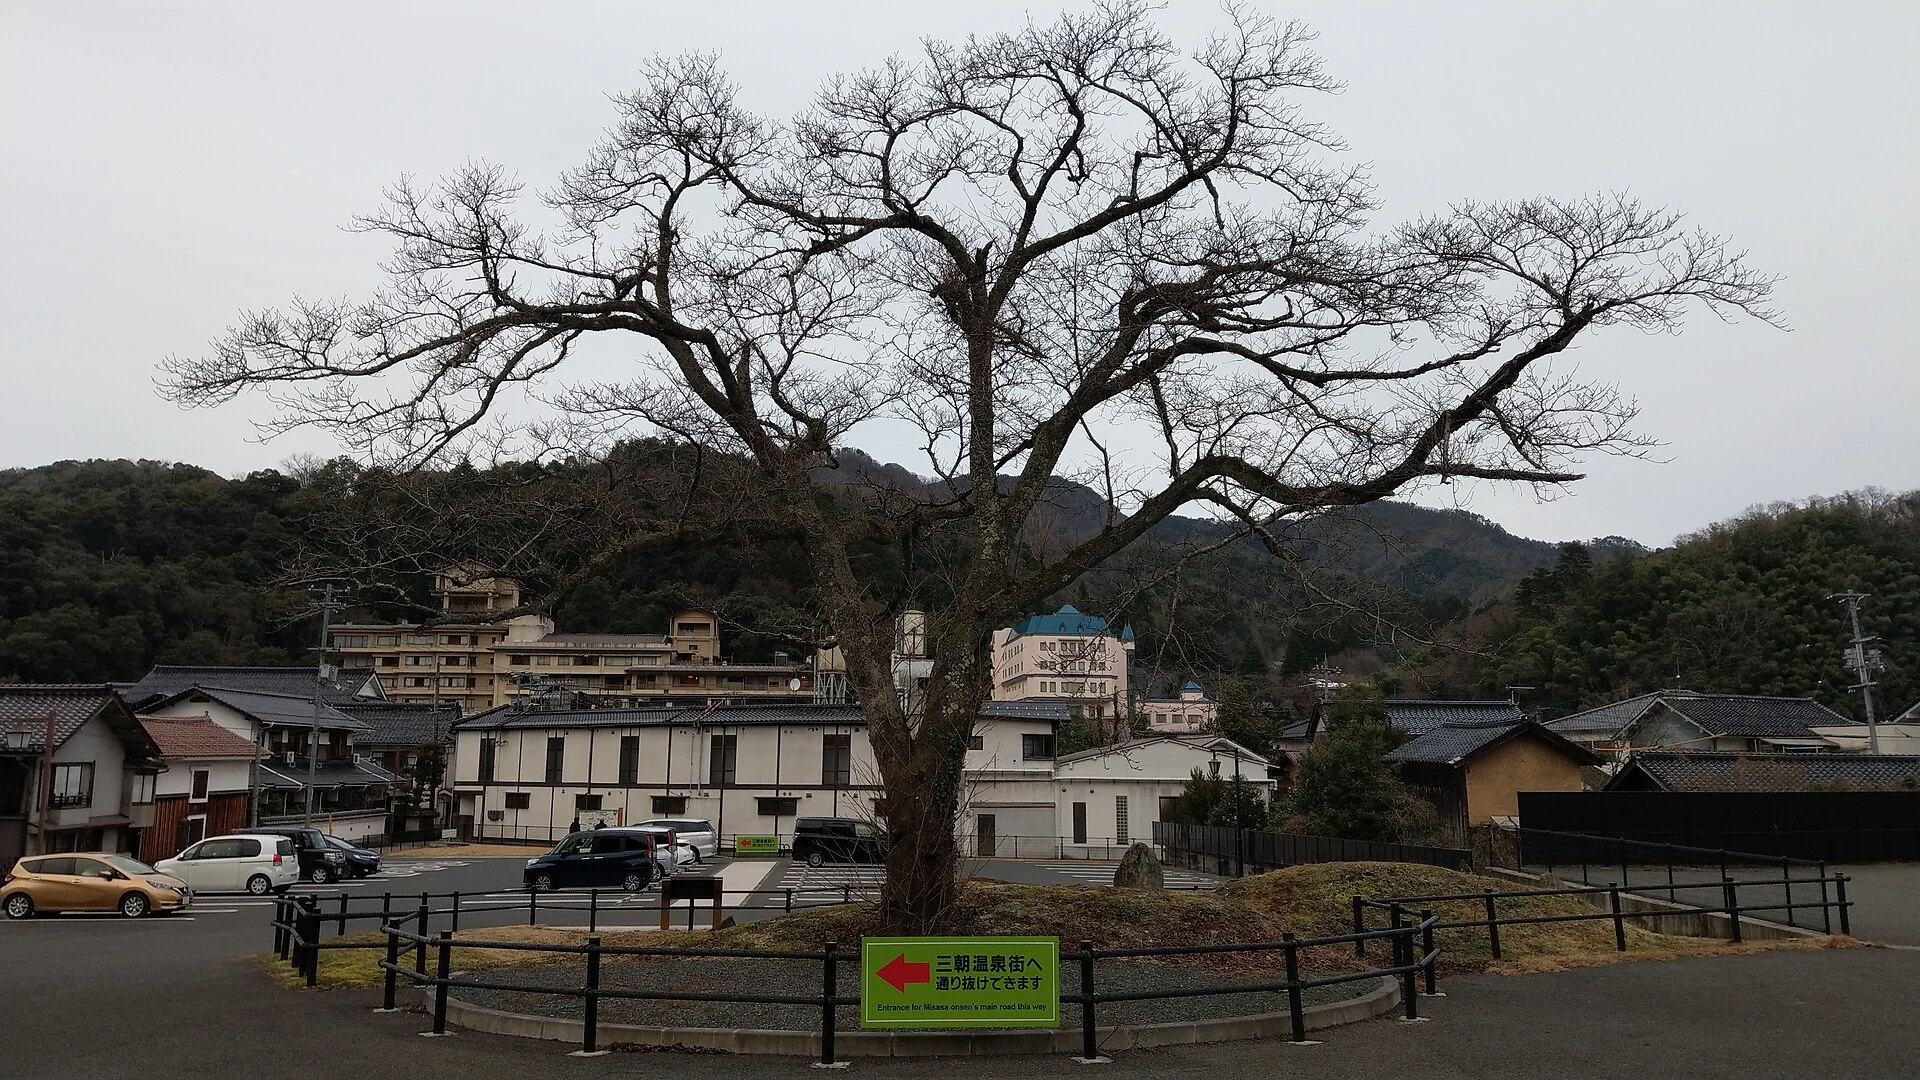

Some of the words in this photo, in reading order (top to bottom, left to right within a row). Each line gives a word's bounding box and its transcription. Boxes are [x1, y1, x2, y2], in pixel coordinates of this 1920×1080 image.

[936, 954, 1043, 973] 三朝温泉街へ
[936, 975, 1043, 991] 通り抜けできます
[877, 1003, 910, 1012] Entrance
[911, 1003, 922, 1011] for
[923, 1003, 949, 1011] Misasa
[950, 1003, 979, 1011] onsen's
[980, 1003, 998, 1011] main
[999, 1002, 1016, 1011] road
[1017, 1002, 1031, 1011] this
[1031, 1003, 1047, 1012] way
